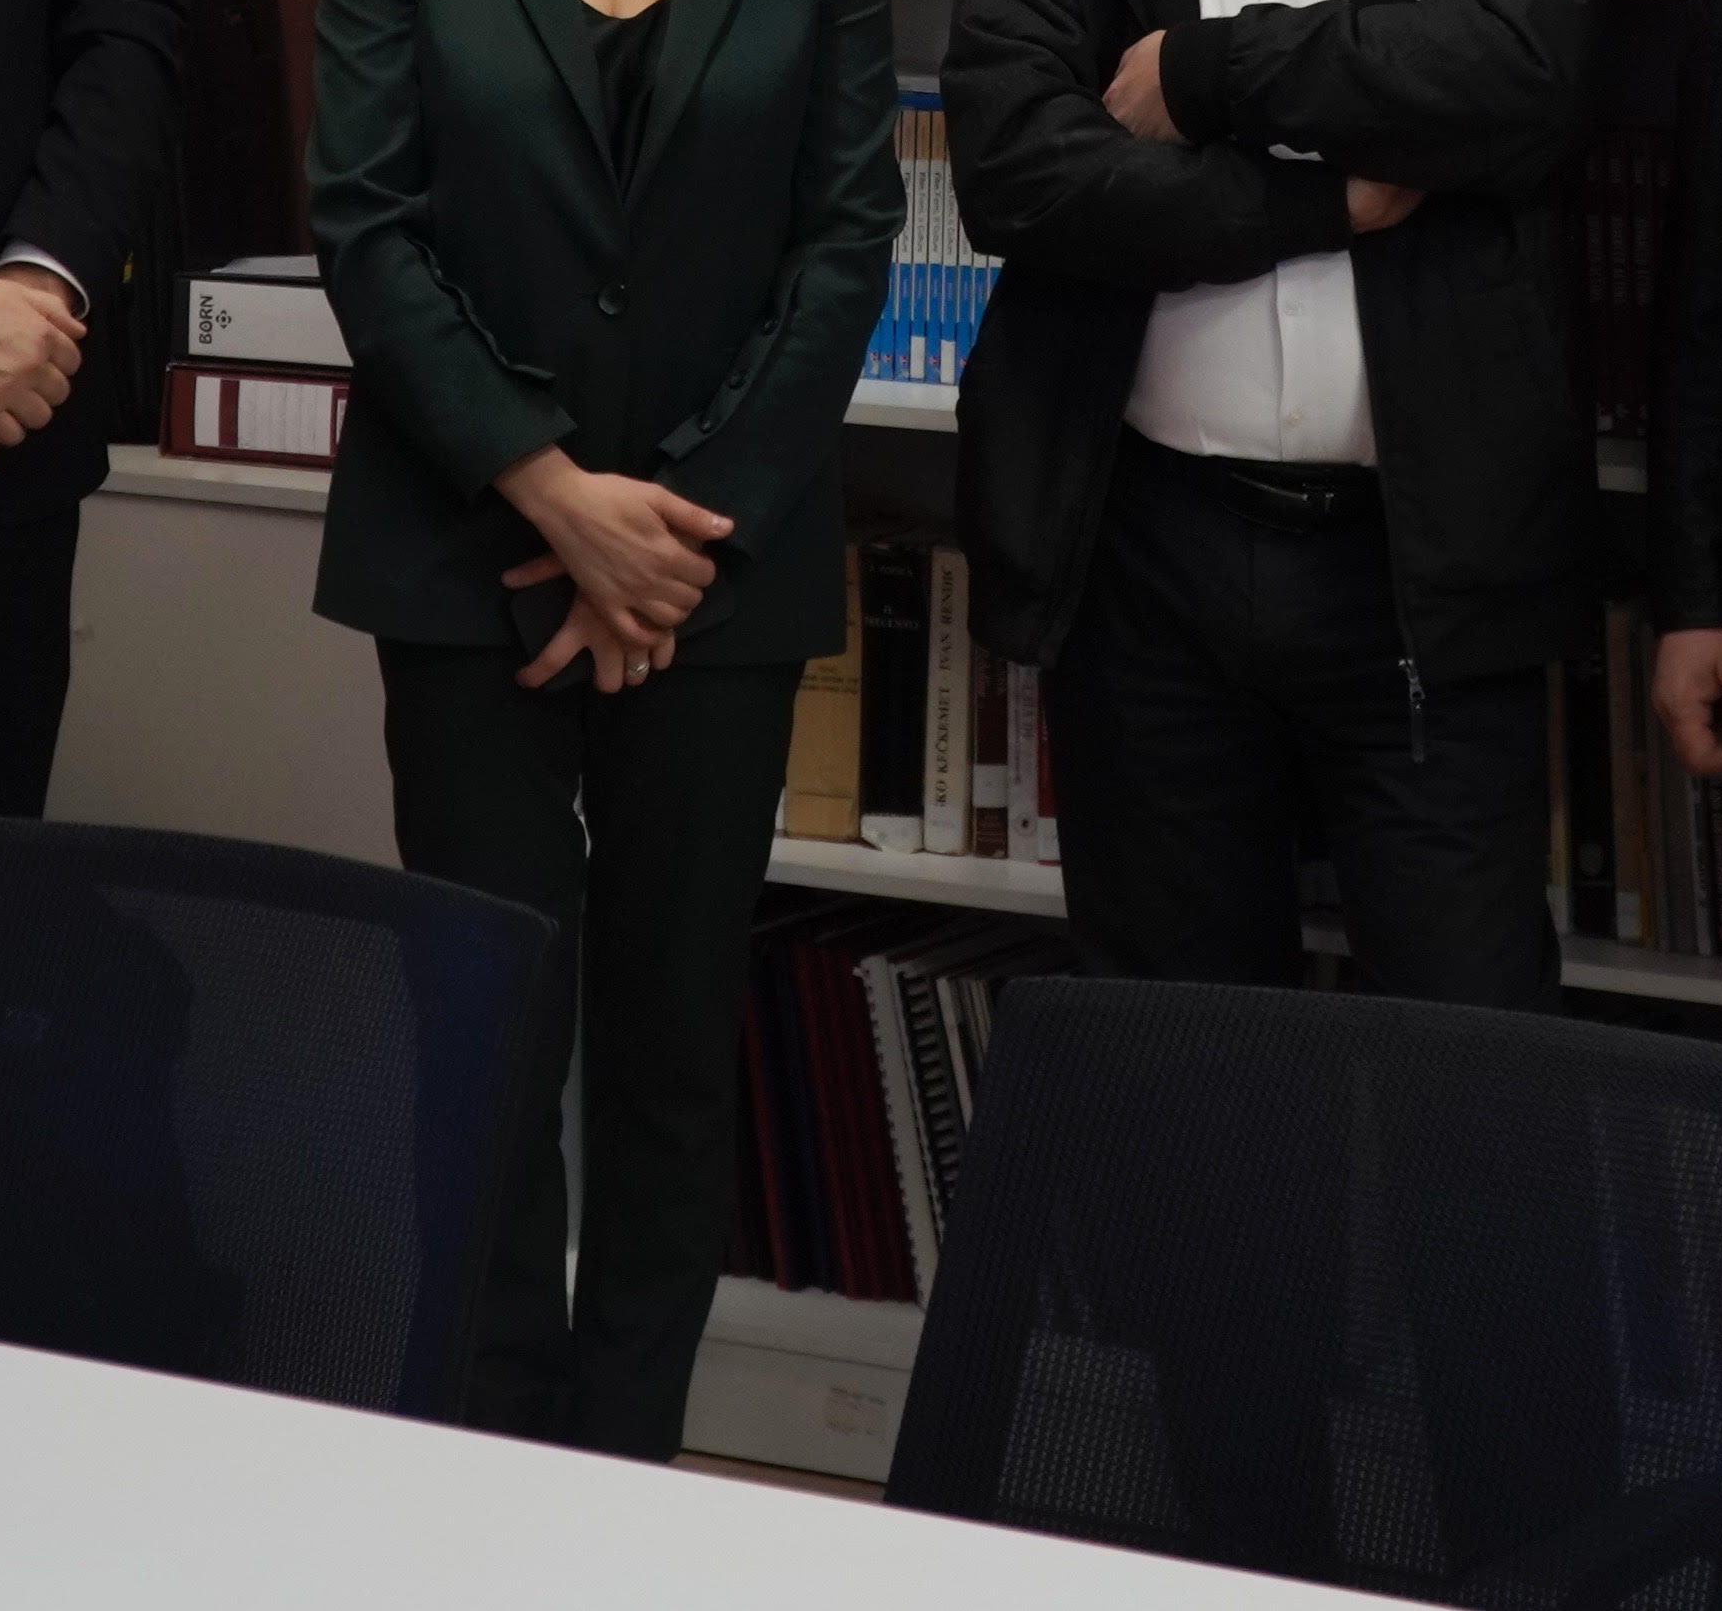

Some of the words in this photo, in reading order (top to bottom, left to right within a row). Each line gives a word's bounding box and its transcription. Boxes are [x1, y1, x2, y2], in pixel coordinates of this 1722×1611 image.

[199, 295, 213, 344] BORN
[940, 634, 953, 670] IVAN
[934, 687, 951, 774] KEČKEMET
